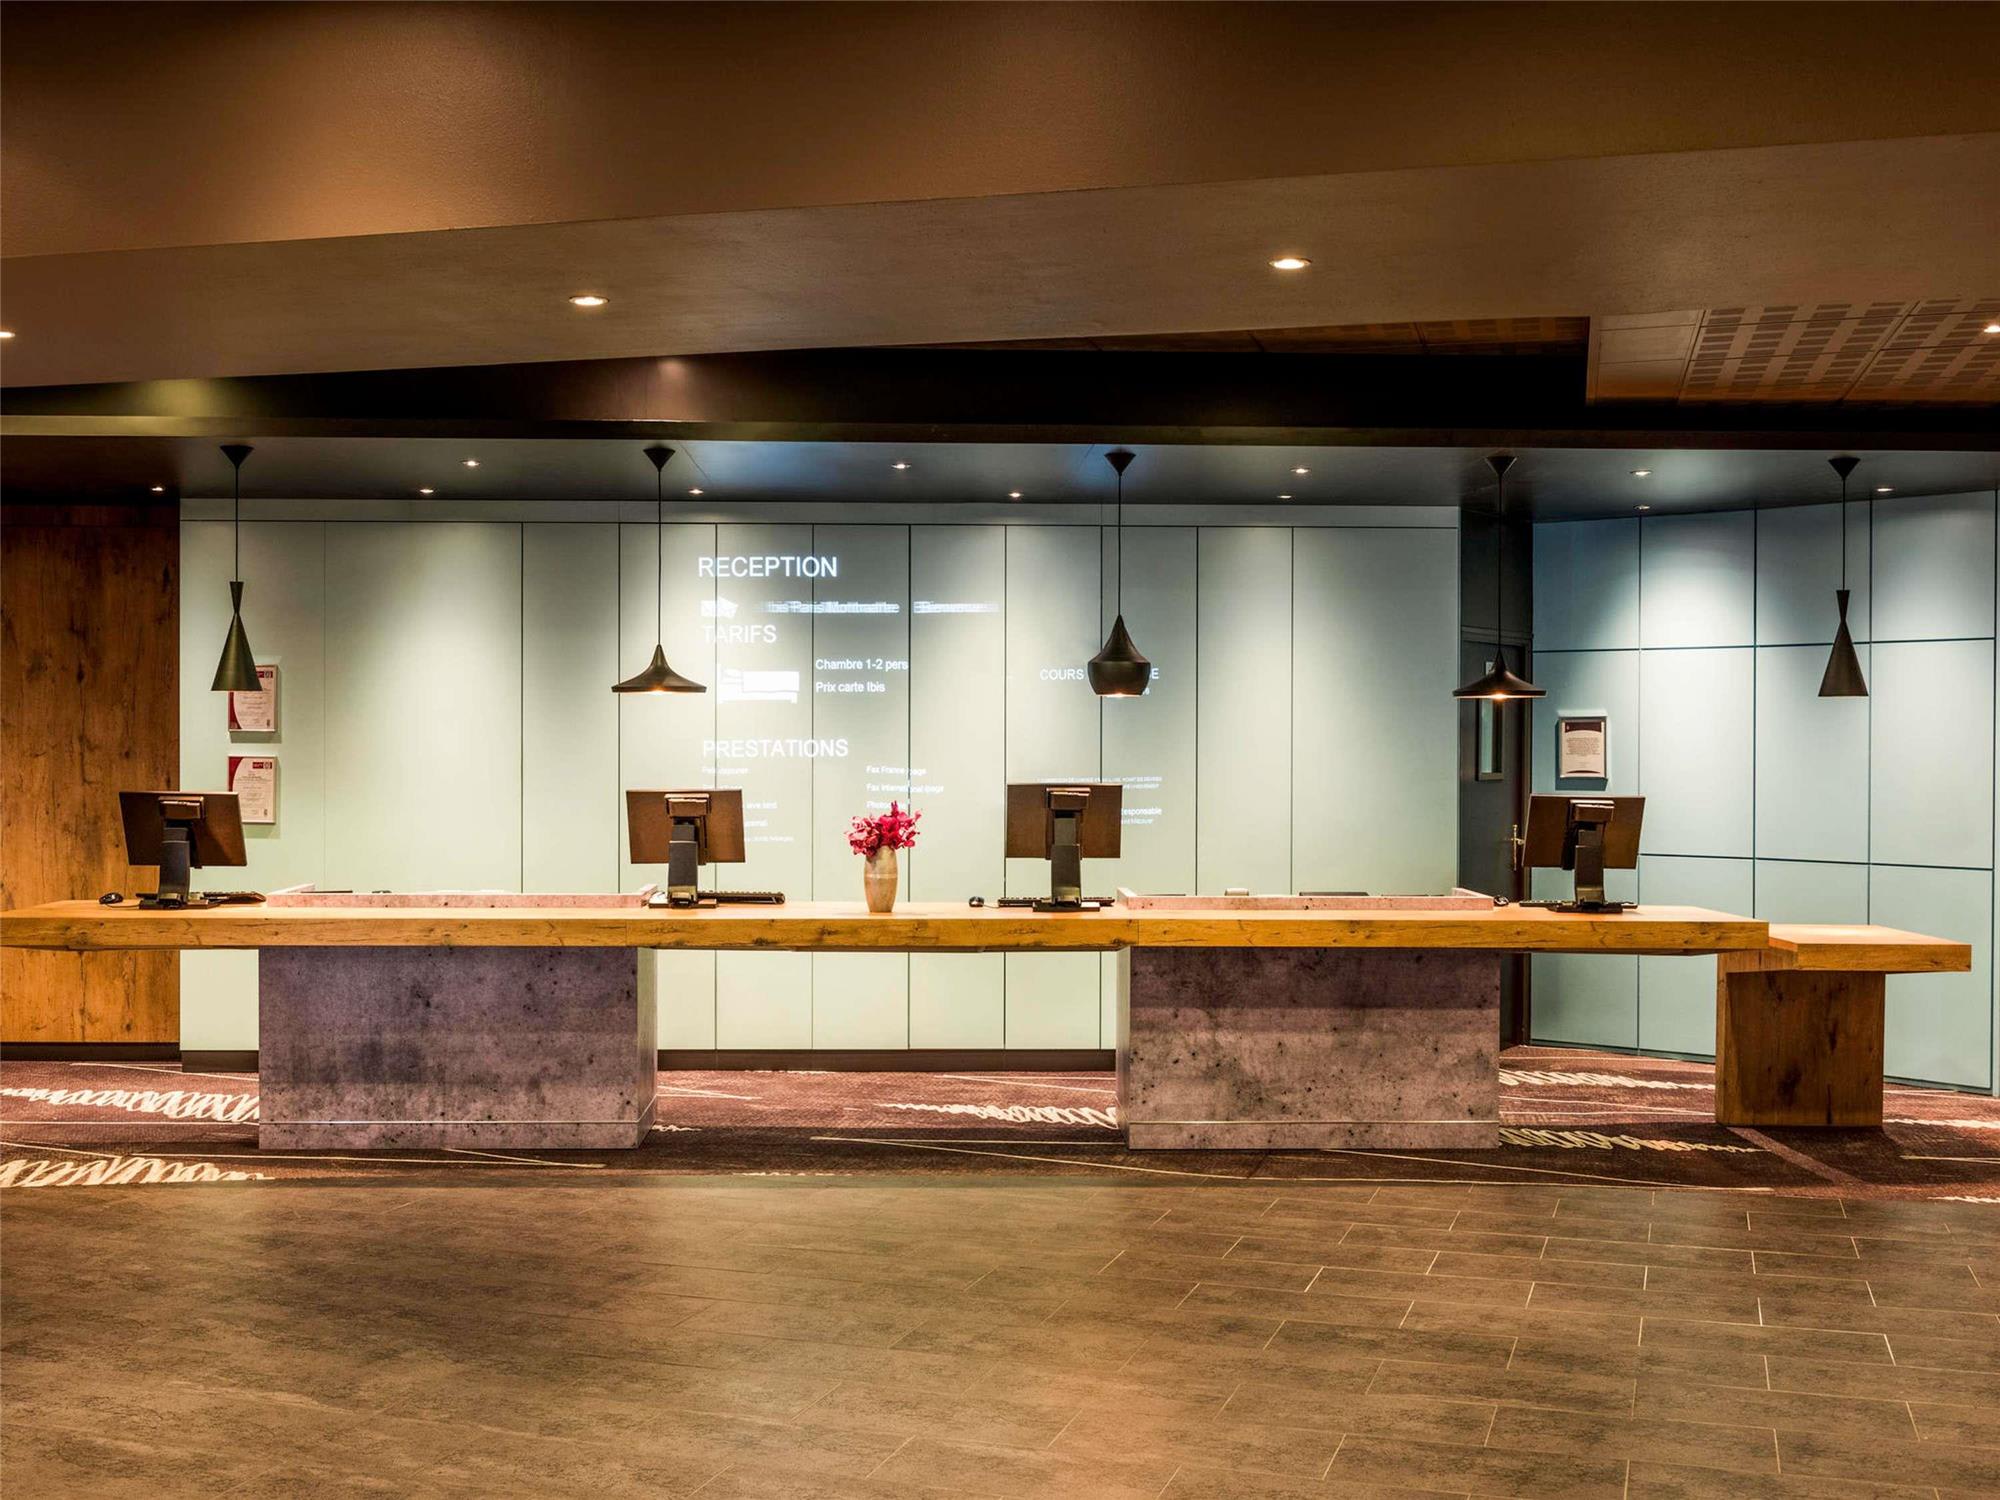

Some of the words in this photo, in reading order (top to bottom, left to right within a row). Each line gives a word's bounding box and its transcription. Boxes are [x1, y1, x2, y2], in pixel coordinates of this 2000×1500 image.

[698, 556, 838, 577] RECEPTION
[702, 624, 777, 644] TARIFS
[815, 659, 863, 670] Chambre
[866, 660, 884, 670] 1-2
[885, 660, 909, 672] pers
[1040, 667, 1085, 681] COURS
[815, 680, 836, 693] Prix
[837, 681, 864, 693] carte
[867, 681, 886, 693] Ibis
[702, 738, 849, 758] PRESTATIONS
